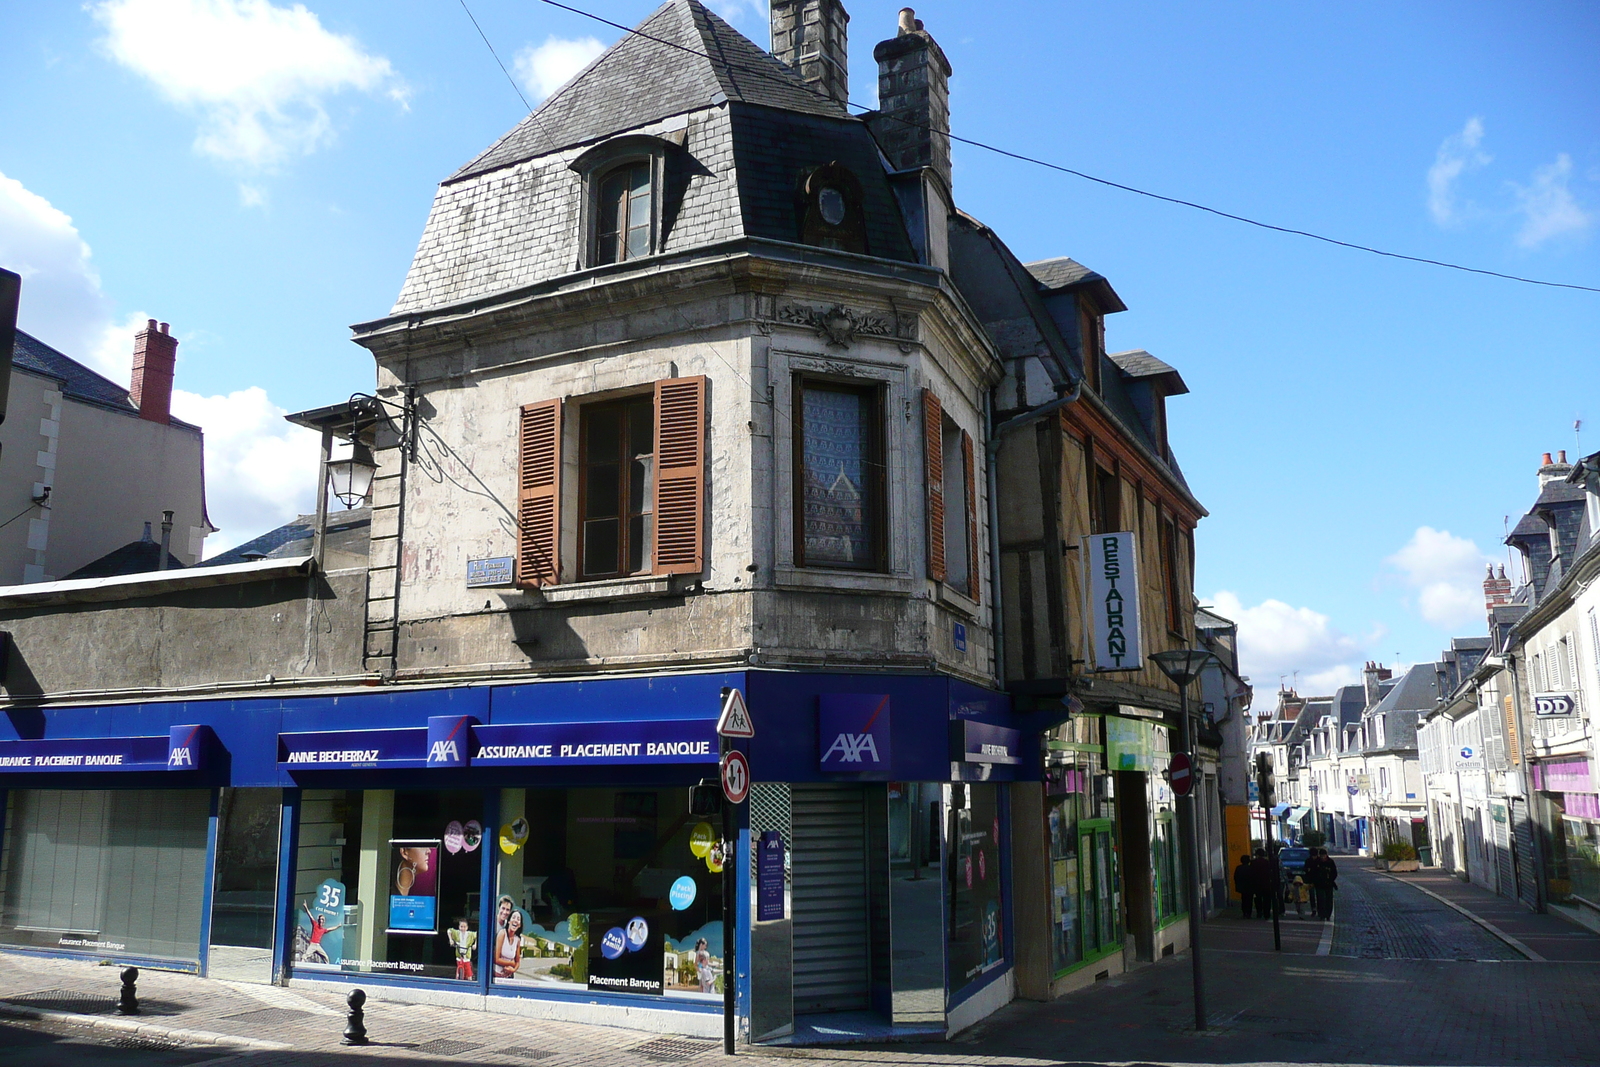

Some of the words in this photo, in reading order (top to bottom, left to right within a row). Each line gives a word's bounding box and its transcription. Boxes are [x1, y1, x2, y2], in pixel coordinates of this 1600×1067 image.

[1102, 536, 1126, 667] RESTAURANT
[1536, 699, 1569, 714] DD
[427, 740, 460, 762] AXA
[476, 745, 552, 759] ASSURANCE
[560, 743, 641, 757] PLACEMENT
[647, 741, 710, 755] BANQUE
[820, 733, 880, 762] AXA
[34, 755, 83, 766] PLACEMENT
[85, 755, 122, 765] BANQUE
[168, 747, 192, 766] AXA
[287, 751, 318, 763] ANNE
[318, 750, 379, 762] BECHERRAZ
[693, 832, 707, 840] Pack
[693, 839, 711, 847] Jardin
[767, 840, 779, 849] AXA
[676, 884, 691, 893] Pack
[58, 937, 82, 946] Assurance
[82, 939, 106, 948] Placement
[106, 942, 125, 951] Banque
[602, 938, 623, 951] Famille
[607, 933, 622, 945] Pack
[335, 958, 366, 967] Assurance
[366, 959, 398, 969] Placement
[399, 961, 424, 972] Banque
[589, 975, 628, 987] Placement
[629, 978, 660, 990] Banque
